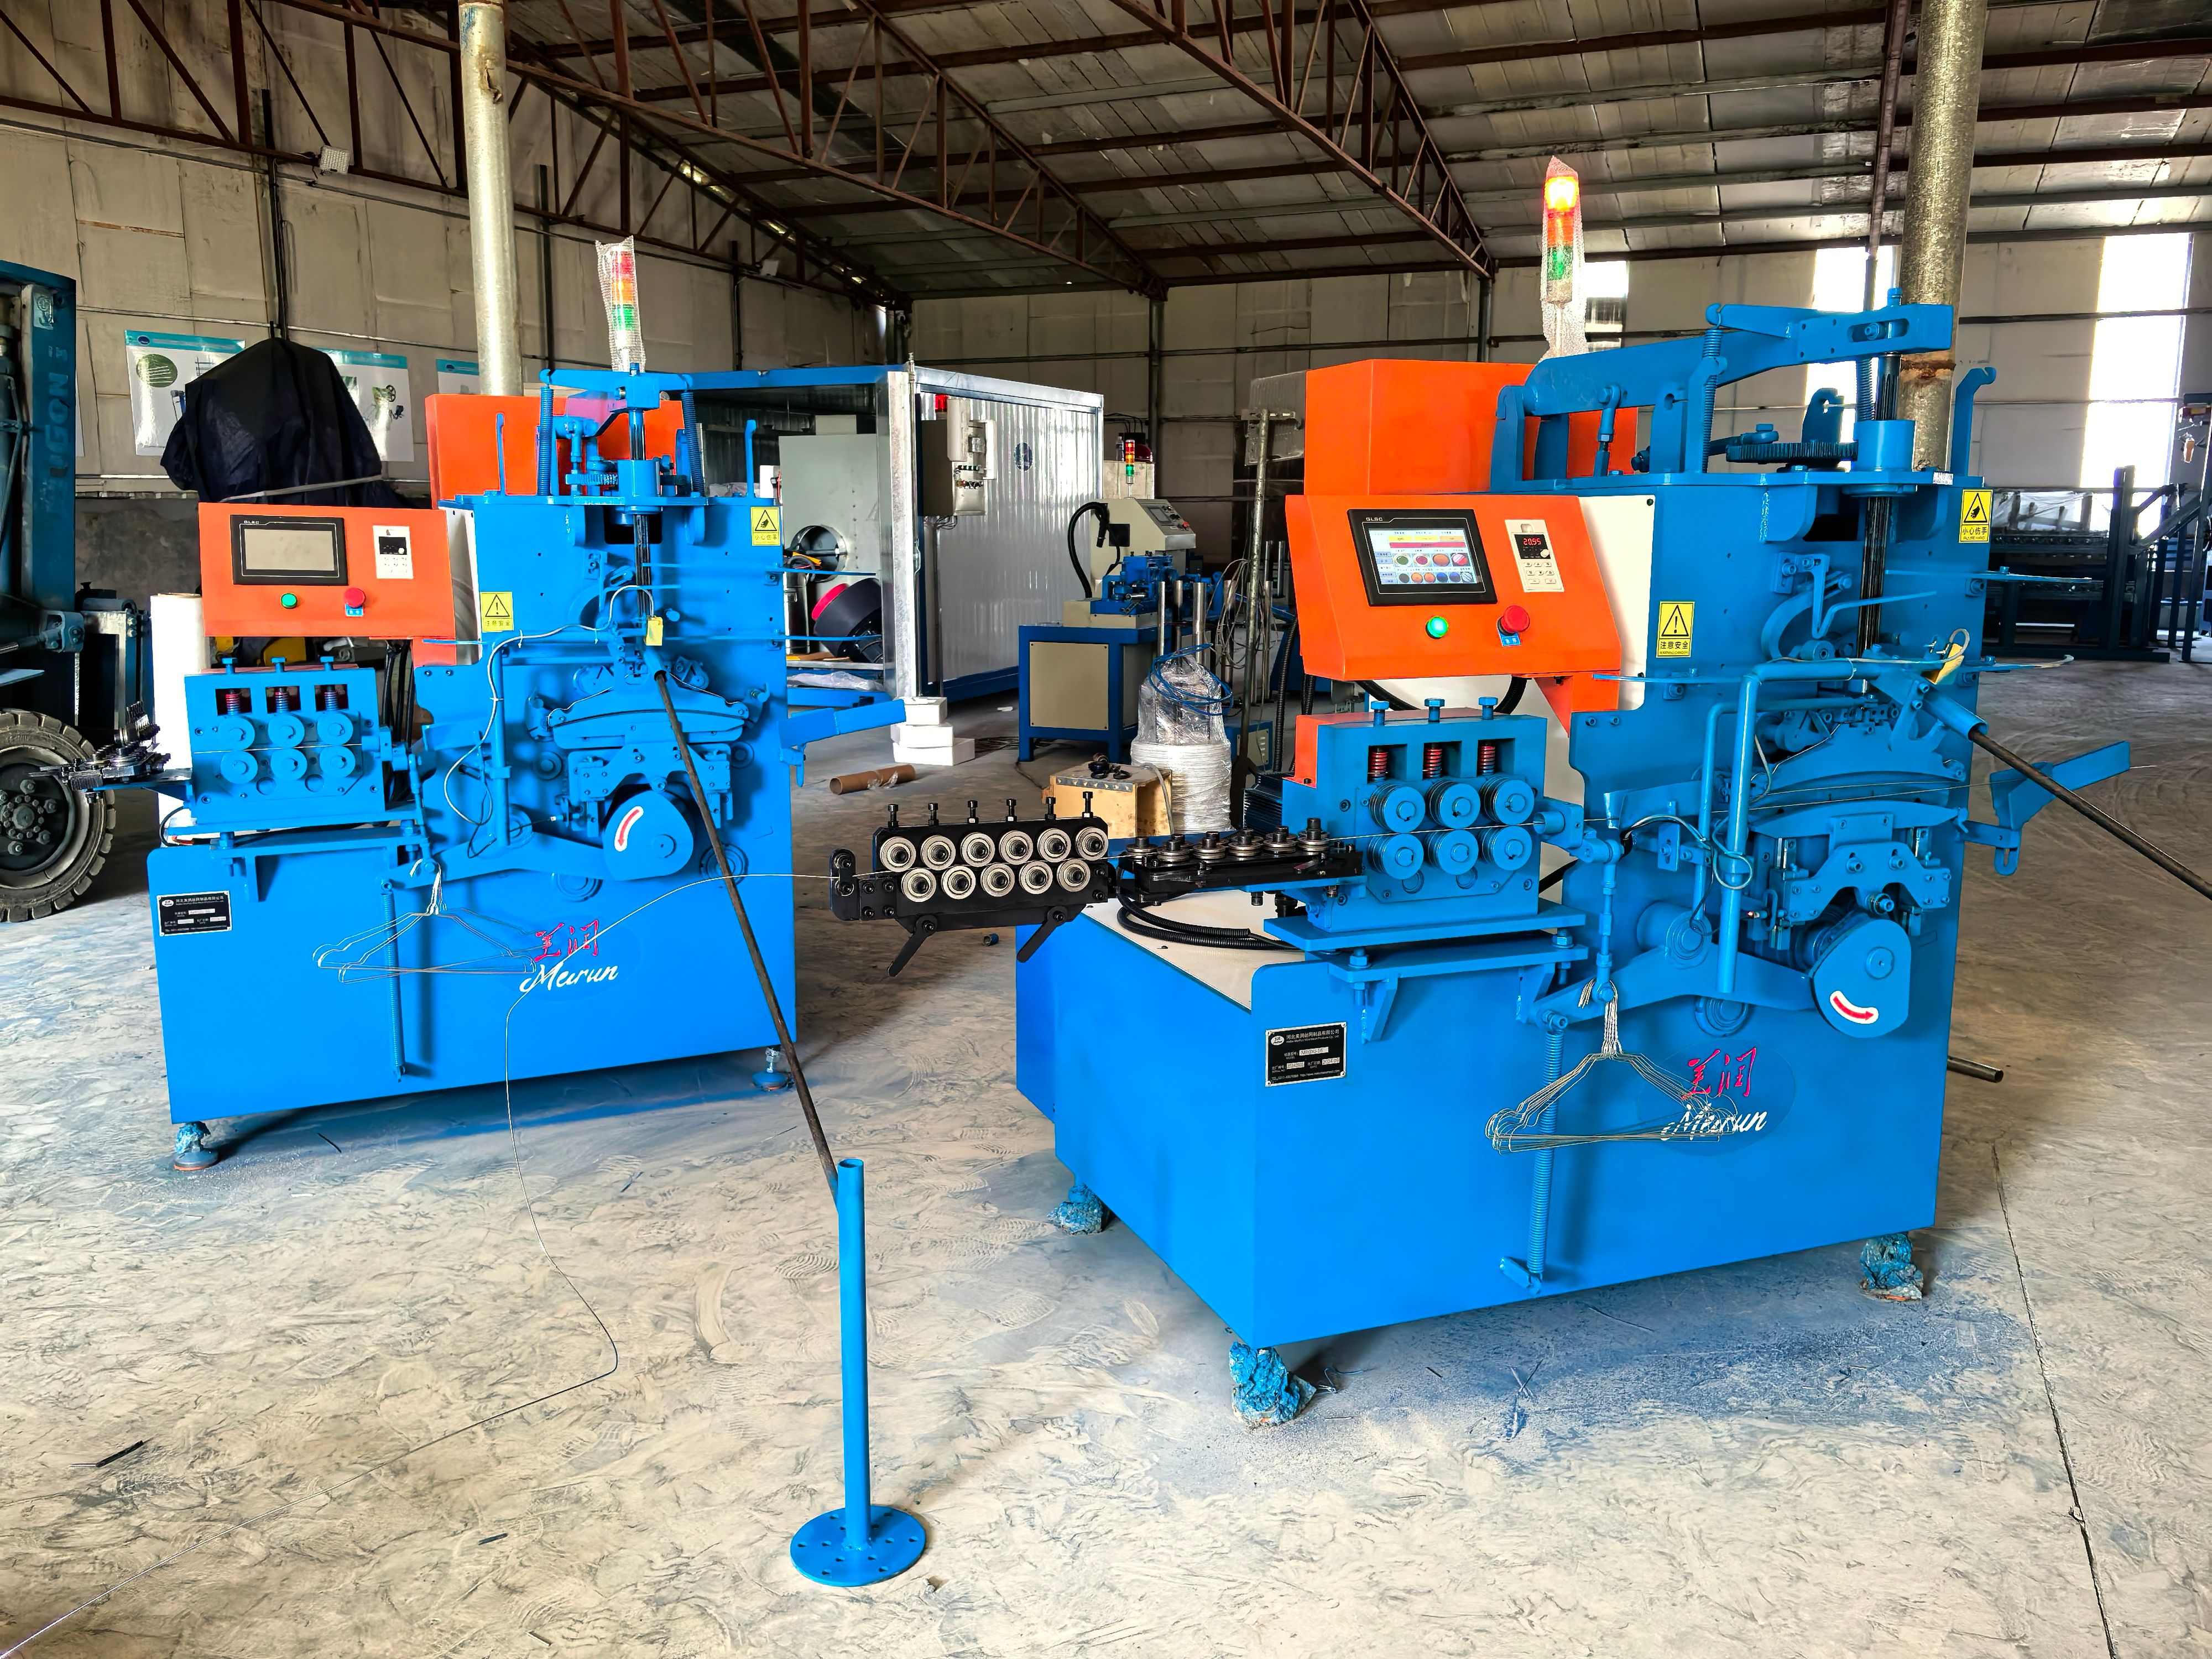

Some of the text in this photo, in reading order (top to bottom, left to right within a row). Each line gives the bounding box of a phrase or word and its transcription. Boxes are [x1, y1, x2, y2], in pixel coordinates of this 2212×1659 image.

[1963, 526, 1987, 535] 小心伤手
[1660, 640, 1688, 649] 注意安全
